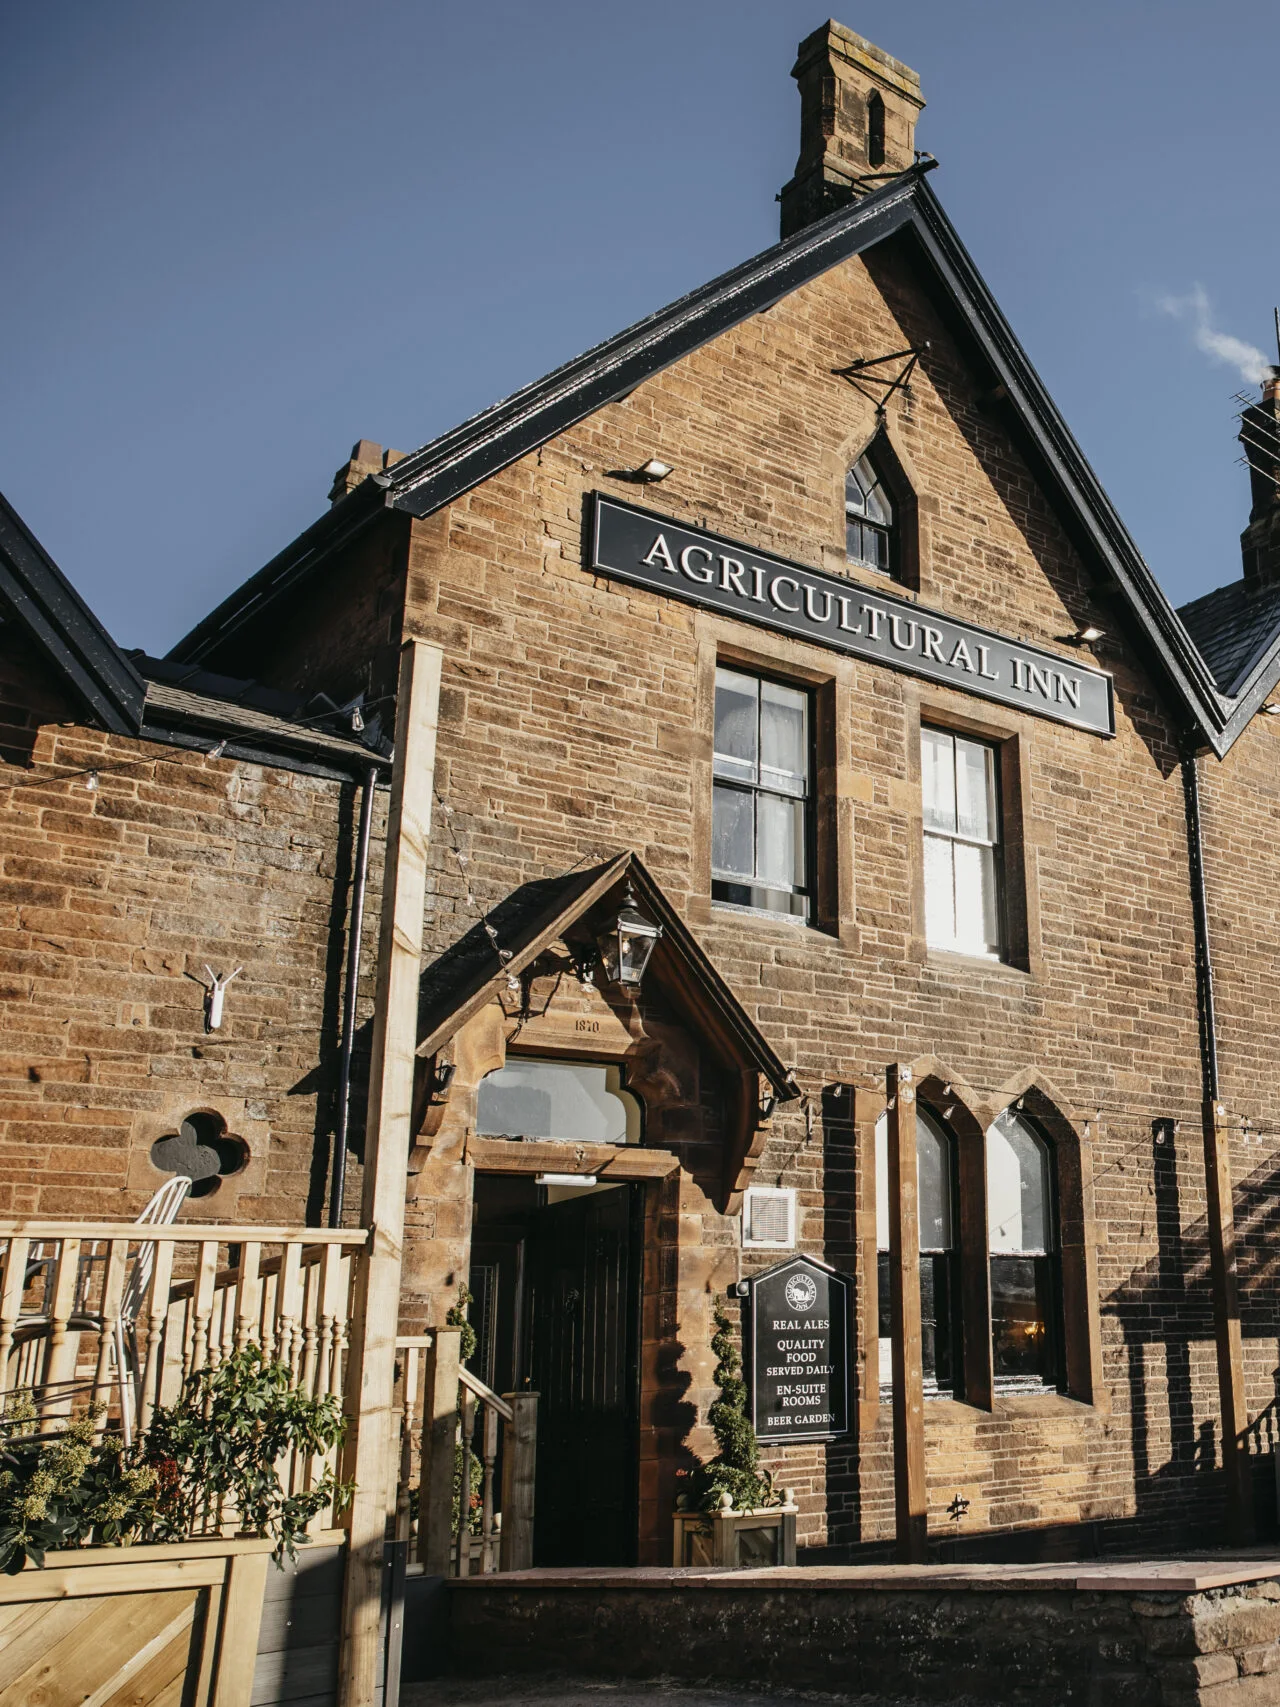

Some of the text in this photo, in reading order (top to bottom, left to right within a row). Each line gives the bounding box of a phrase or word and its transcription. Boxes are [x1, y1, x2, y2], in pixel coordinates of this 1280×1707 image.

[642, 532, 1082, 708] AGRICULTURAL INN
[787, 1274, 816, 1300] AGRICULTURAL
[795, 1302, 808, 1310] INN
[772, 1320, 830, 1330] REAL ALES
[777, 1339, 825, 1351] QUALITY
[786, 1352, 817, 1363] FOOD
[766, 1365, 835, 1376] SERVED DAILY
[776, 1384, 826, 1395] EN-SUITE
[782, 1395, 821, 1407] ROOMS
[767, 1413, 835, 1426] BEER GARDEN
